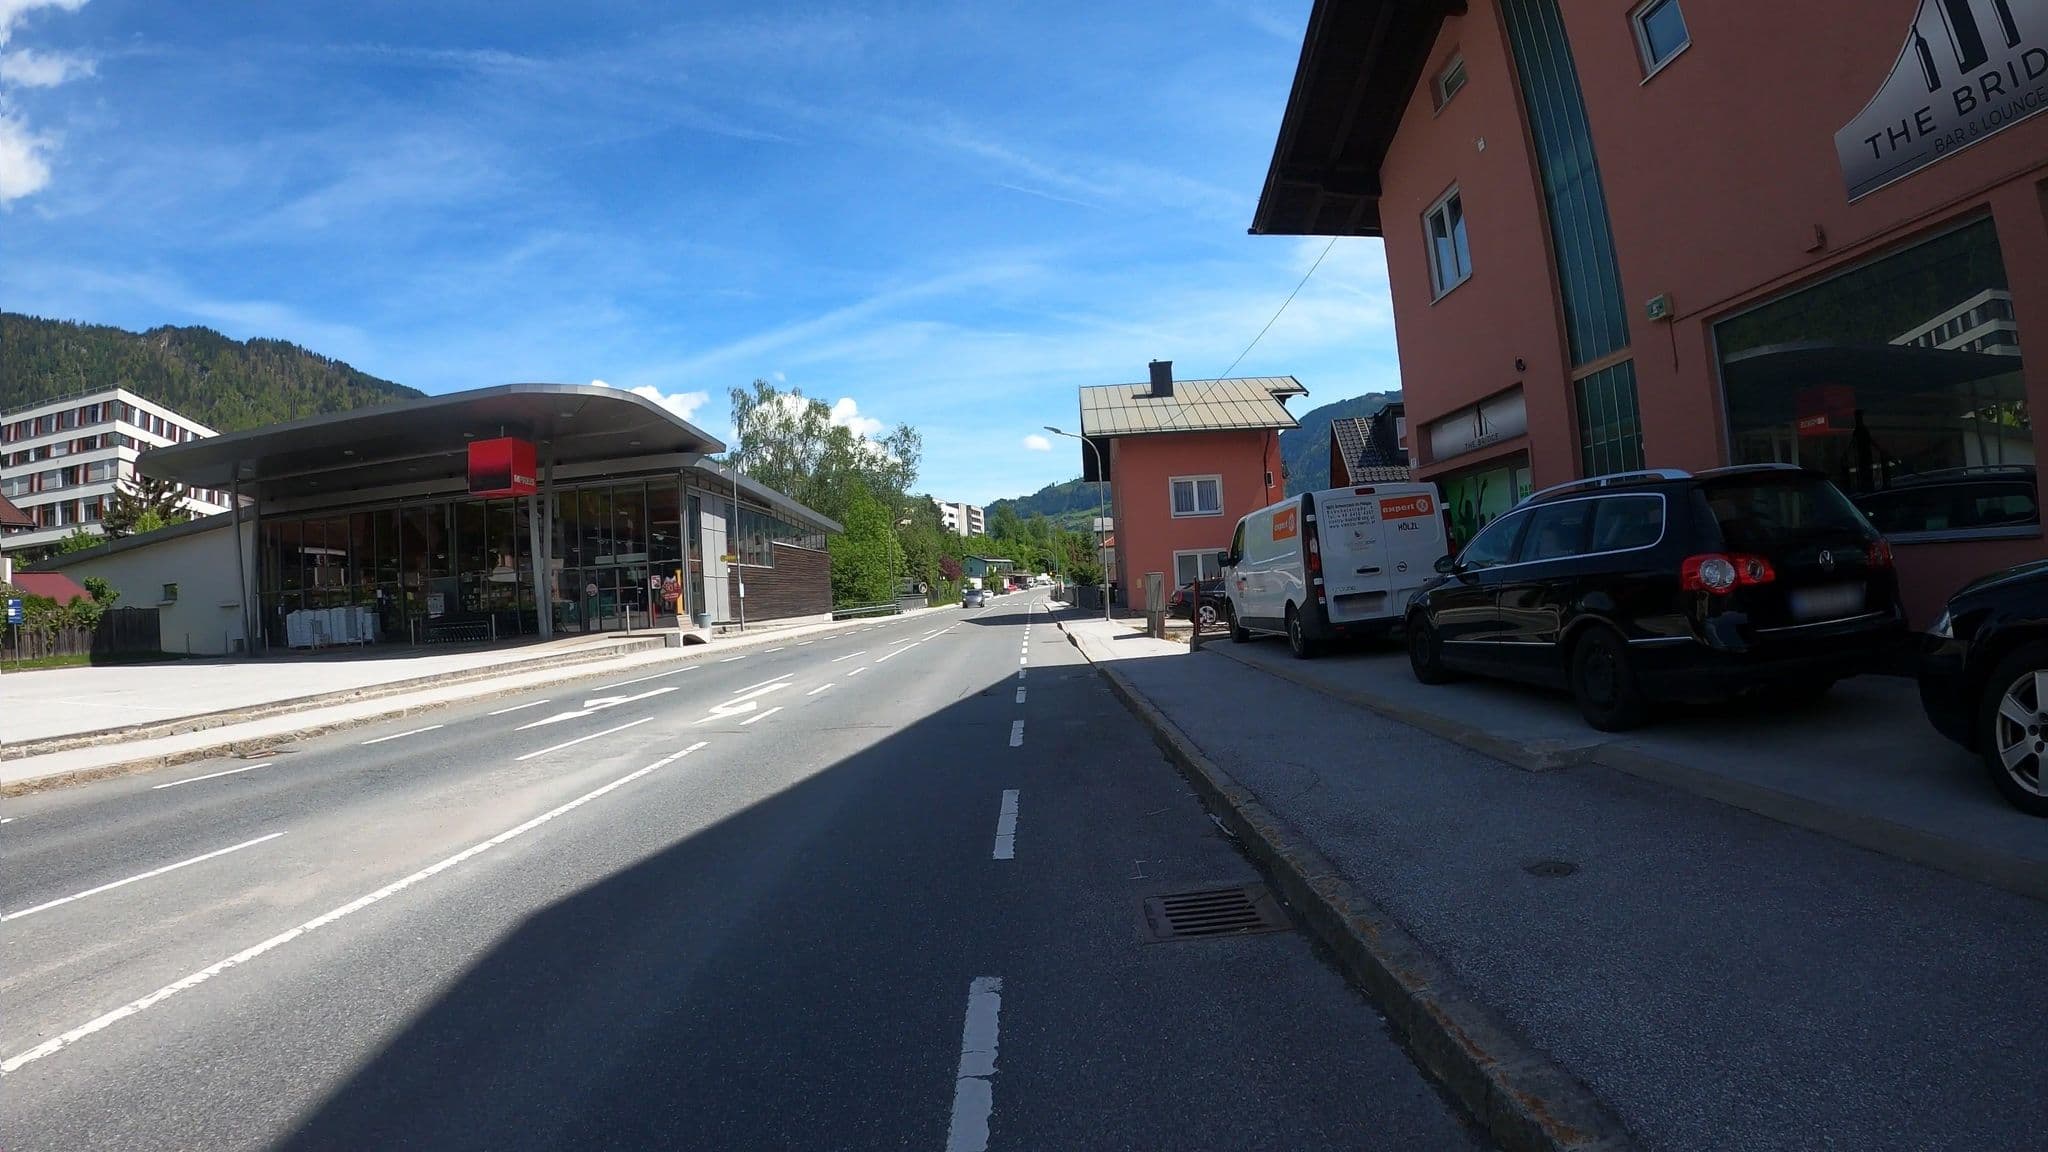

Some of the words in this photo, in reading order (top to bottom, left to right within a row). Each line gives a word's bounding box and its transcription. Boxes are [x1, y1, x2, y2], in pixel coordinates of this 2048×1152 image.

[1864, 105, 1937, 160] THE
[1952, 47, 2048, 117] BRID
[1934, 127, 1965, 153] BAR
[1969, 121, 1978, 136] &
[1981, 86, 2047, 130] LOUNGE
